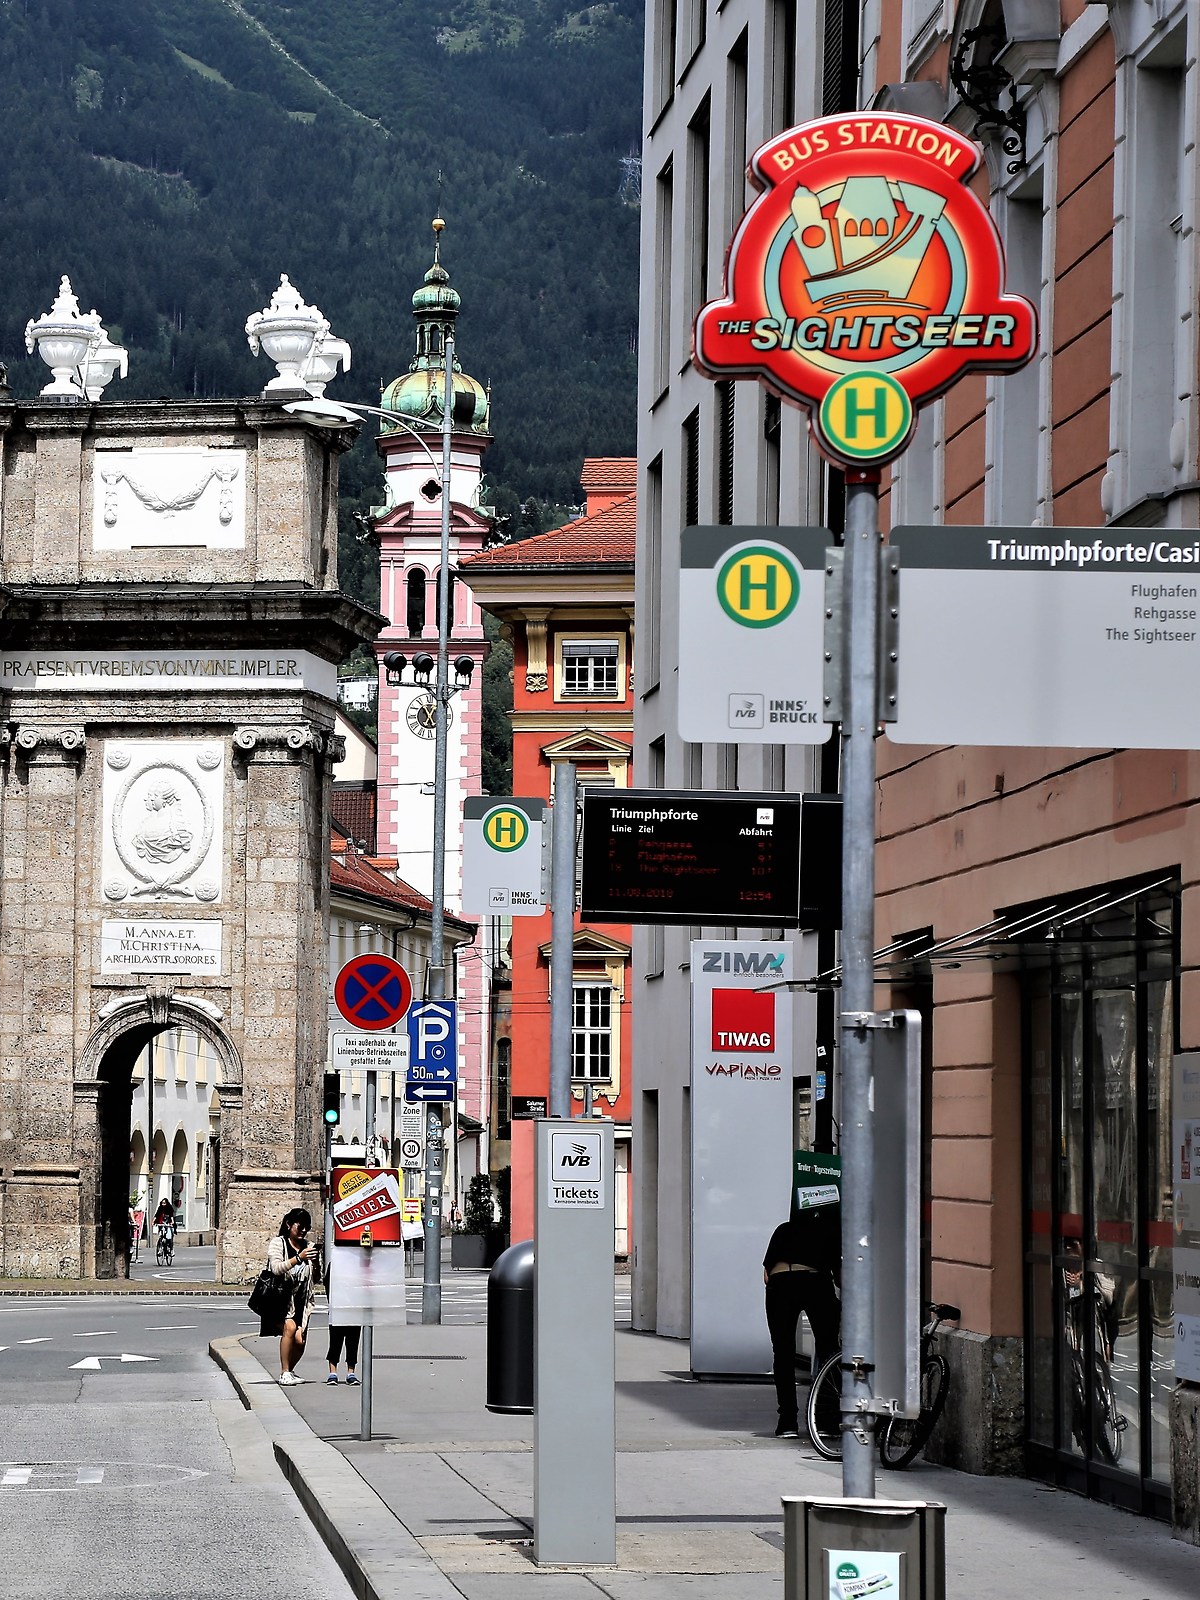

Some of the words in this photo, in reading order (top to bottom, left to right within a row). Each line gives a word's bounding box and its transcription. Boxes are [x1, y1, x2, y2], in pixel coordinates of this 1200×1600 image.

[772, 136, 829, 172] BUS
[837, 121, 962, 167] STATION
[718, 320, 751, 335] THE
[751, 315, 1016, 351] SIGHTSEER
[845, 387, 888, 439] H
[739, 564, 777, 611] H
[1131, 584, 1197, 600] Flughafen
[1134, 607, 1197, 622] Rehgasse
[1106, 628, 1129, 641] The
[1134, 628, 1196, 644] Sightseer
[735, 709, 757, 718] IVB
[769, 712, 819, 724] BRUCK
[610, 807, 699, 821] Triumphpforte
[495, 817, 517, 843] H
[611, 824, 633, 833] Linie
[638, 824, 654, 834] Ziel
[739, 827, 773, 837] Abfahrt
[739, 890, 773, 901] 12:54
[703, 952, 785, 973] ZIMA
[345, 1038, 357, 1046] Taxi
[358, 1038, 387, 1047] außerhalb
[387, 1039, 398, 1047] der
[418, 1017, 450, 1060] P
[717, 1032, 771, 1047] TIWAG
[337, 1047, 407, 1057] Linienbus-Betriebszeiten
[350, 1057, 376, 1066] gestattet
[377, 1057, 392, 1065] Ende
[403, 1106, 421, 1115] Zone
[407, 1144, 416, 1154] 30
[404, 1159, 419, 1167] Zone
[561, 1155, 591, 1167] IVB
[341, 1177, 370, 1196] INFORMATION
[342, 1174, 362, 1190] BESTE
[553, 1187, 599, 1199] Tickets
[339, 1194, 392, 1225] KURIER
